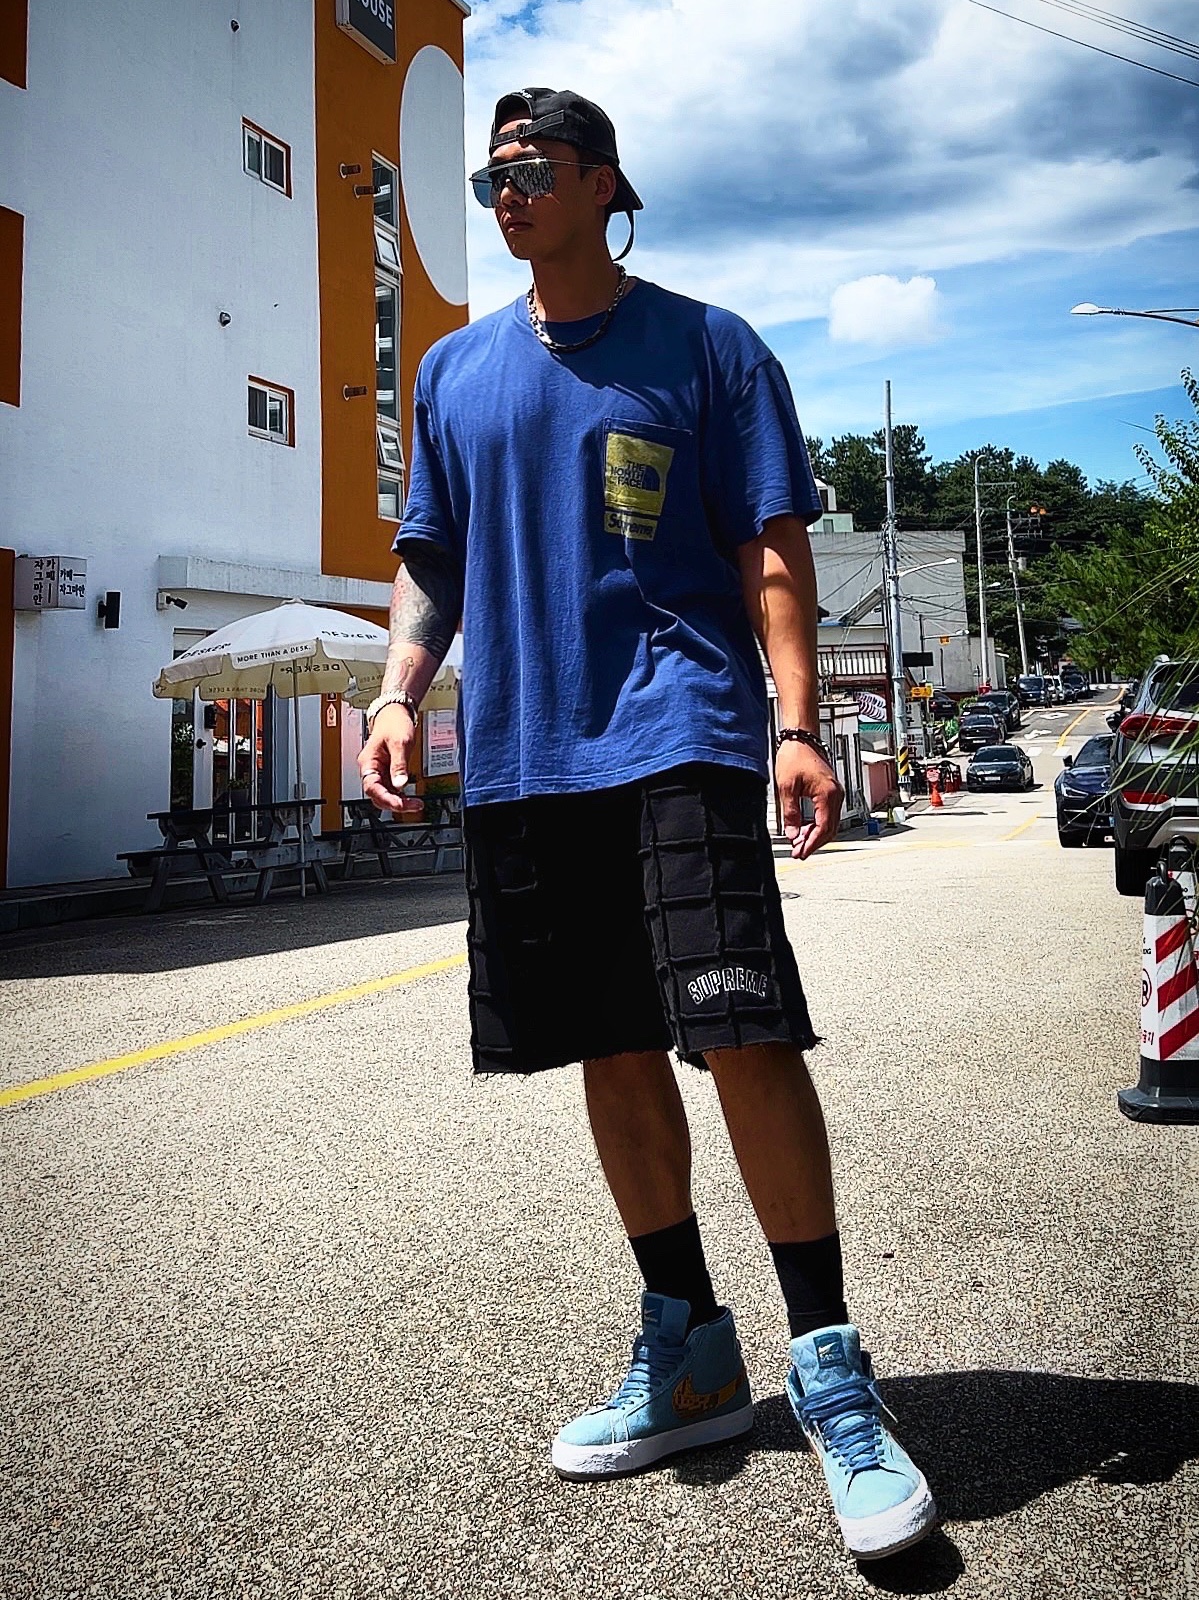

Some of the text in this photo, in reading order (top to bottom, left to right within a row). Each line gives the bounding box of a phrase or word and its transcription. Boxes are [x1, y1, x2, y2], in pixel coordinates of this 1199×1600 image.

[627, 460, 645, 472] THE
[618, 477, 642, 489] FACE
[46, 559, 56, 581] 카페
[237, 653, 258, 663] MORE
[261, 650, 281, 659] THAN
[687, 967, 768, 1005] SUPREME
